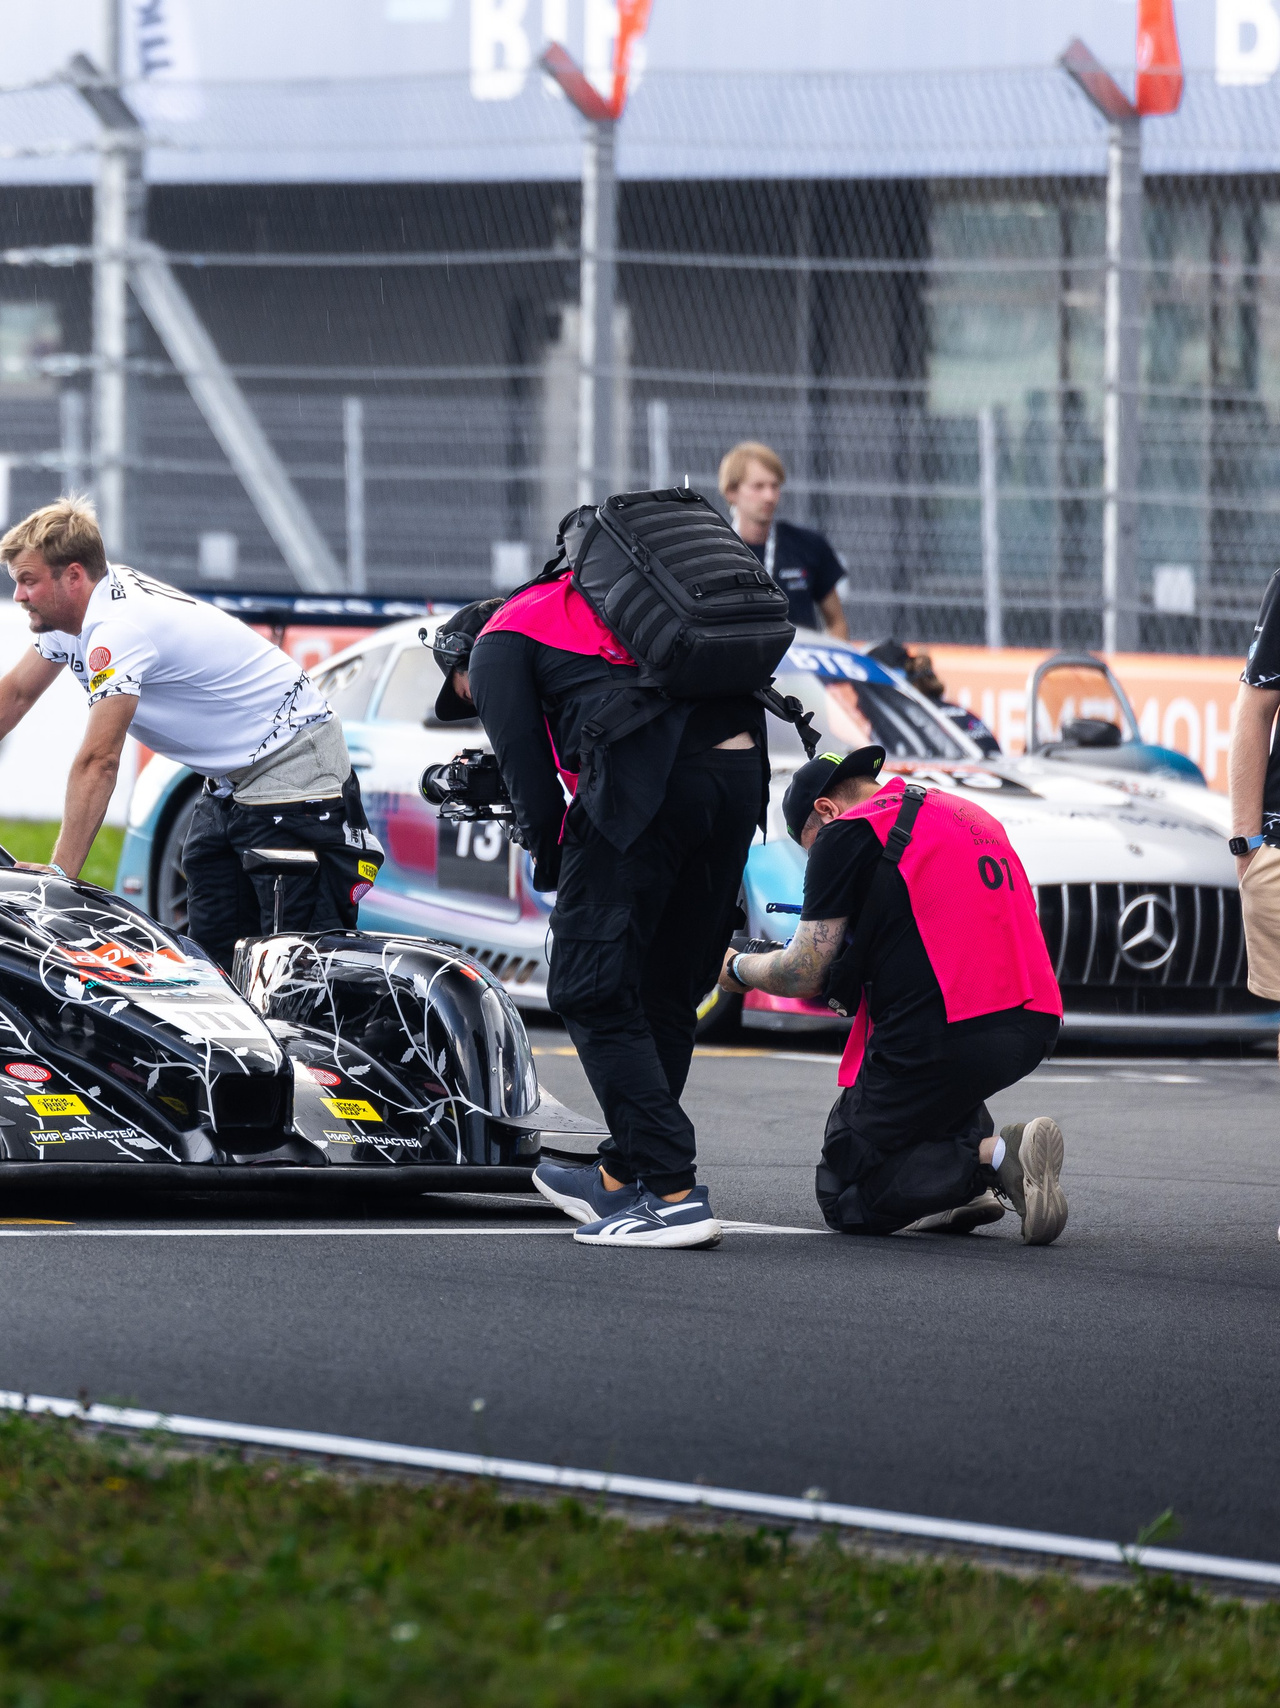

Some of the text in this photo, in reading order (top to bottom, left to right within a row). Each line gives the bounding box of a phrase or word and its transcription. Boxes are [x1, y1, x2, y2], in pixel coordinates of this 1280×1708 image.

[978, 855, 1015, 892] 01
[173, 1010, 251, 1031] 111
[32, 1128, 138, 1142] МИР ЗАПЧАСТЕЙ
[325, 1132, 423, 1148] МИР ЗАПЧАСТЕЙ
